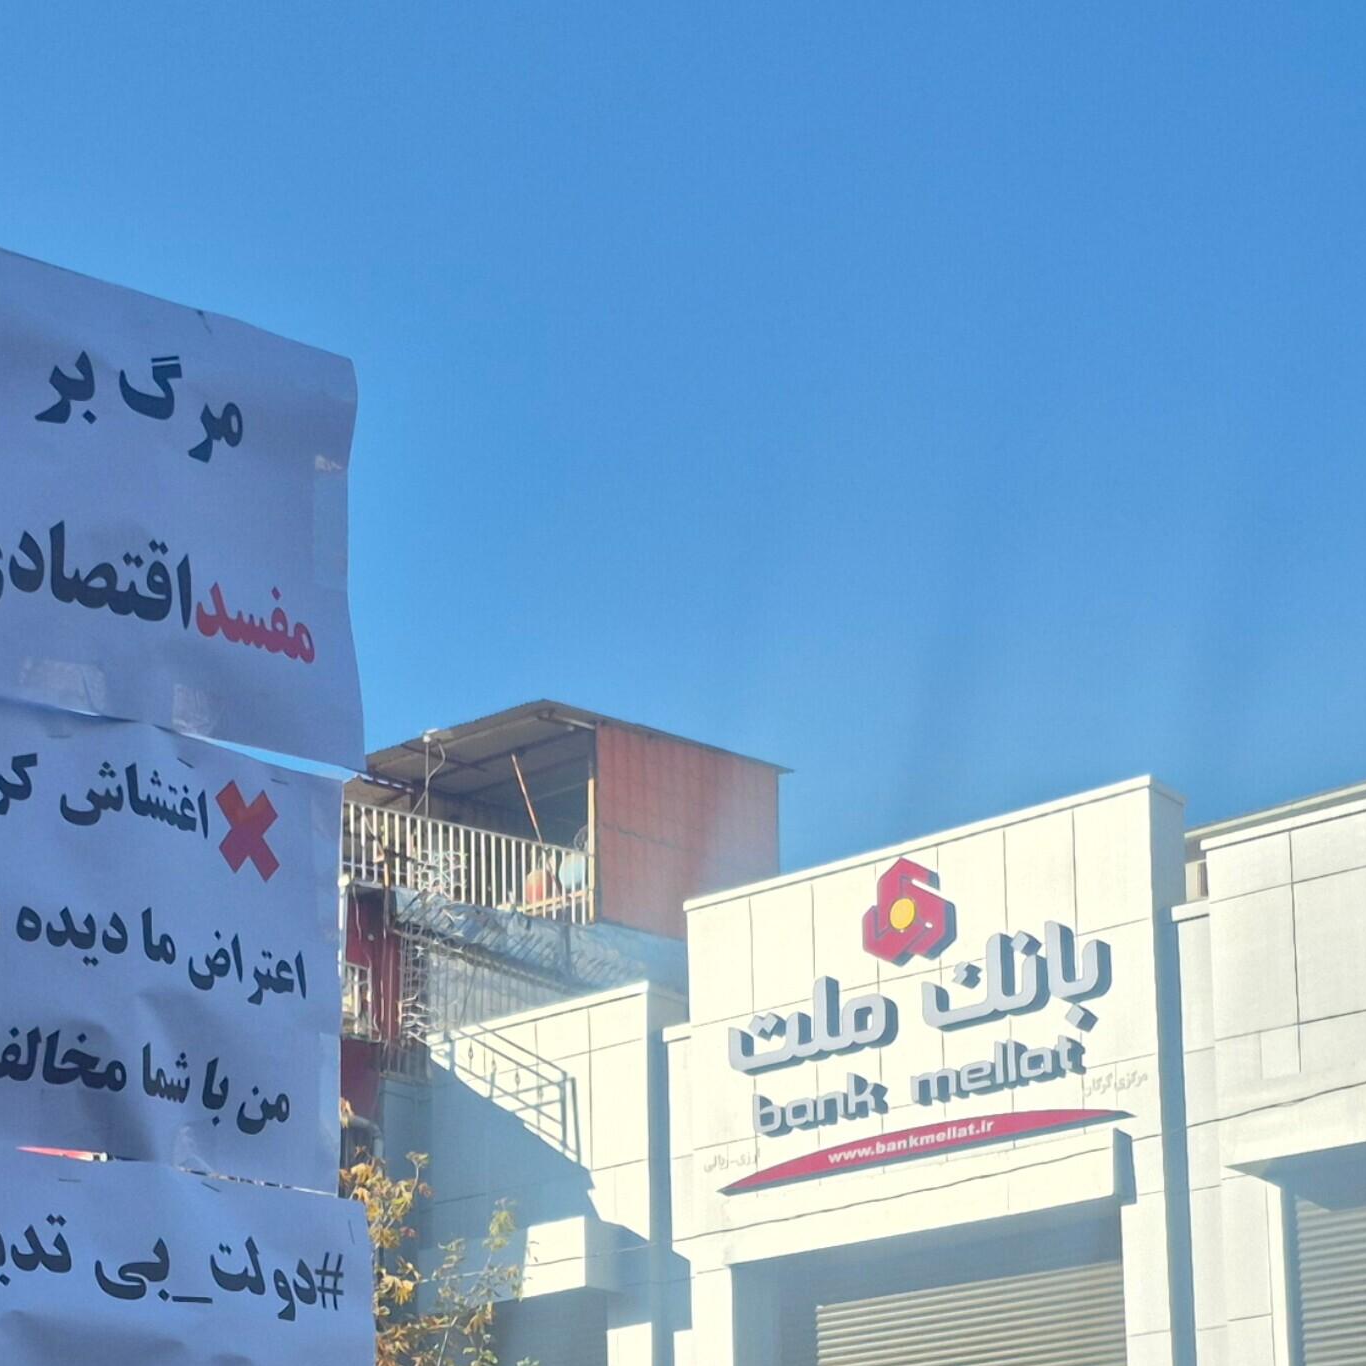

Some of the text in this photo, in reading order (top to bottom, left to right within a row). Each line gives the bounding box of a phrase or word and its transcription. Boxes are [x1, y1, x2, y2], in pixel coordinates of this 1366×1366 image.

[34, 351, 244, 463] مرگ بر
[195, 581, 316, 664] مفسد
[59, 761, 210, 840] اغتشاش
[15, 911, 129, 968] دیده
[141, 907, 177, 965] ما
[188, 930, 307, 1006] اعتراض
[727, 919, 1112, 1076] بانک ملت
[141, 1043, 191, 1105] شما
[202, 1057, 229, 1125] با
[752, 1034, 1087, 1137] bank mellat
[235, 1086, 291, 1135] من
[827, 1117, 995, 1165] www.bankmellat.ir
